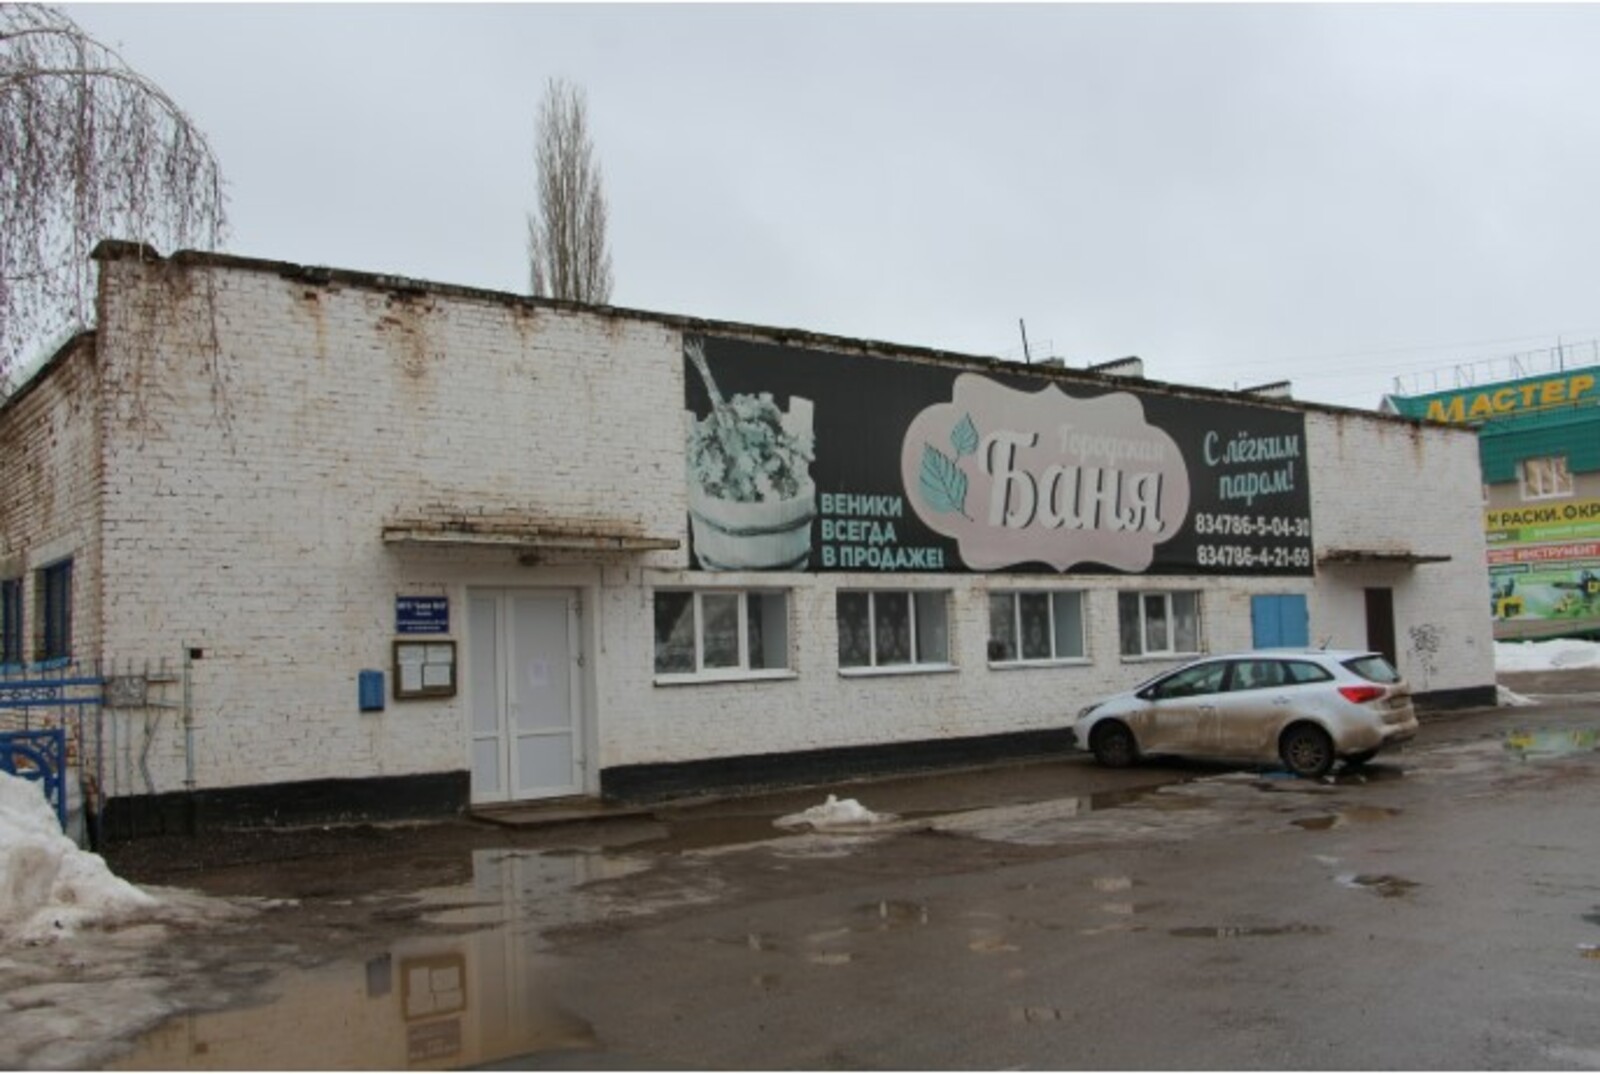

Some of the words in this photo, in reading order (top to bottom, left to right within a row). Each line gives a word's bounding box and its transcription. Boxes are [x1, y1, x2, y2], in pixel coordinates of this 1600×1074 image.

[1426, 374, 1595, 423] МАСТЕР
[1203, 430, 1220, 467] С
[1222, 431, 1300, 464] лёгким
[978, 429, 1166, 534] Баня
[1220, 461, 1295, 507] паром!
[820, 492, 903, 518] ВЕНИКИ
[820, 518, 897, 547] ВСЕГДА
[821, 544, 837, 568] В
[839, 545, 945, 571] ПРОДАЖЕ!
